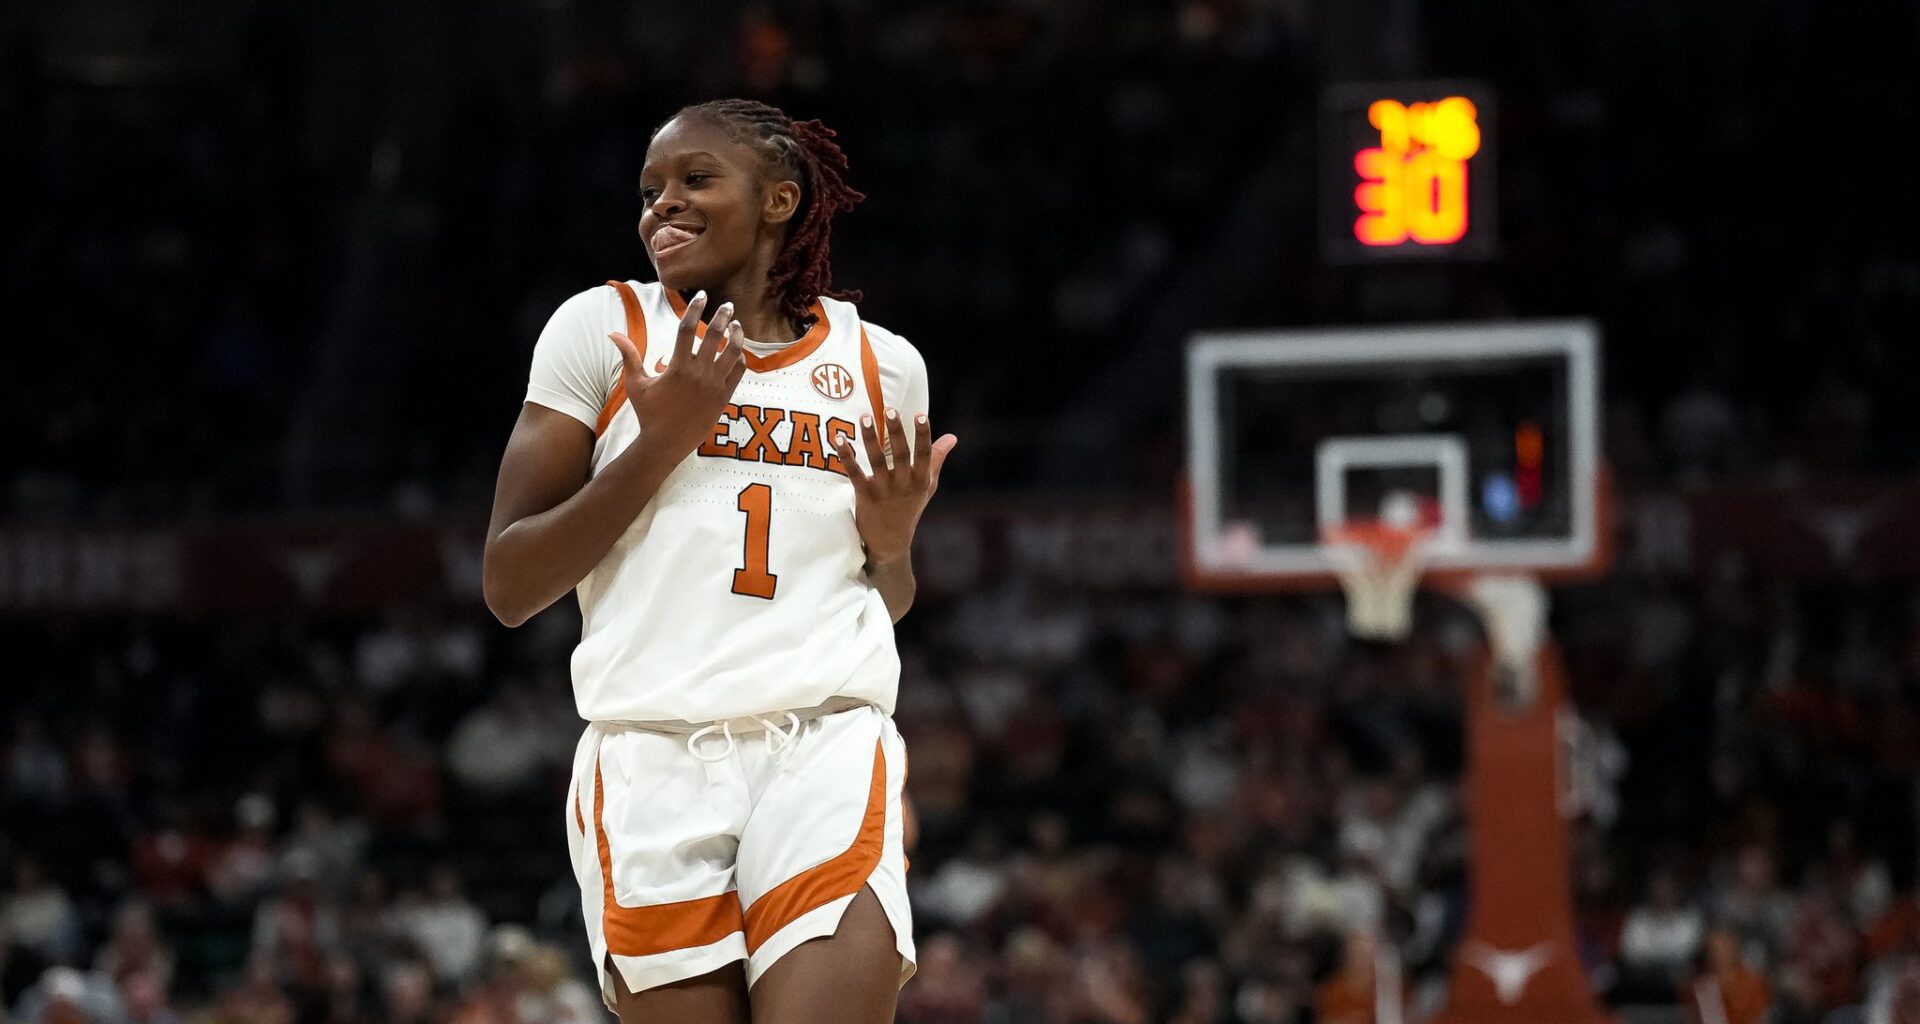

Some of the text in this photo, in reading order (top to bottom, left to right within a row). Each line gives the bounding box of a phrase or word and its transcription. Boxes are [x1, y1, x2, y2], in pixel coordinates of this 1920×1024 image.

[1354, 148, 1468, 246] 30
[814, 364, 855, 399] SEC
[697, 403, 858, 478] EXAS
[731, 482, 777, 601] 1
